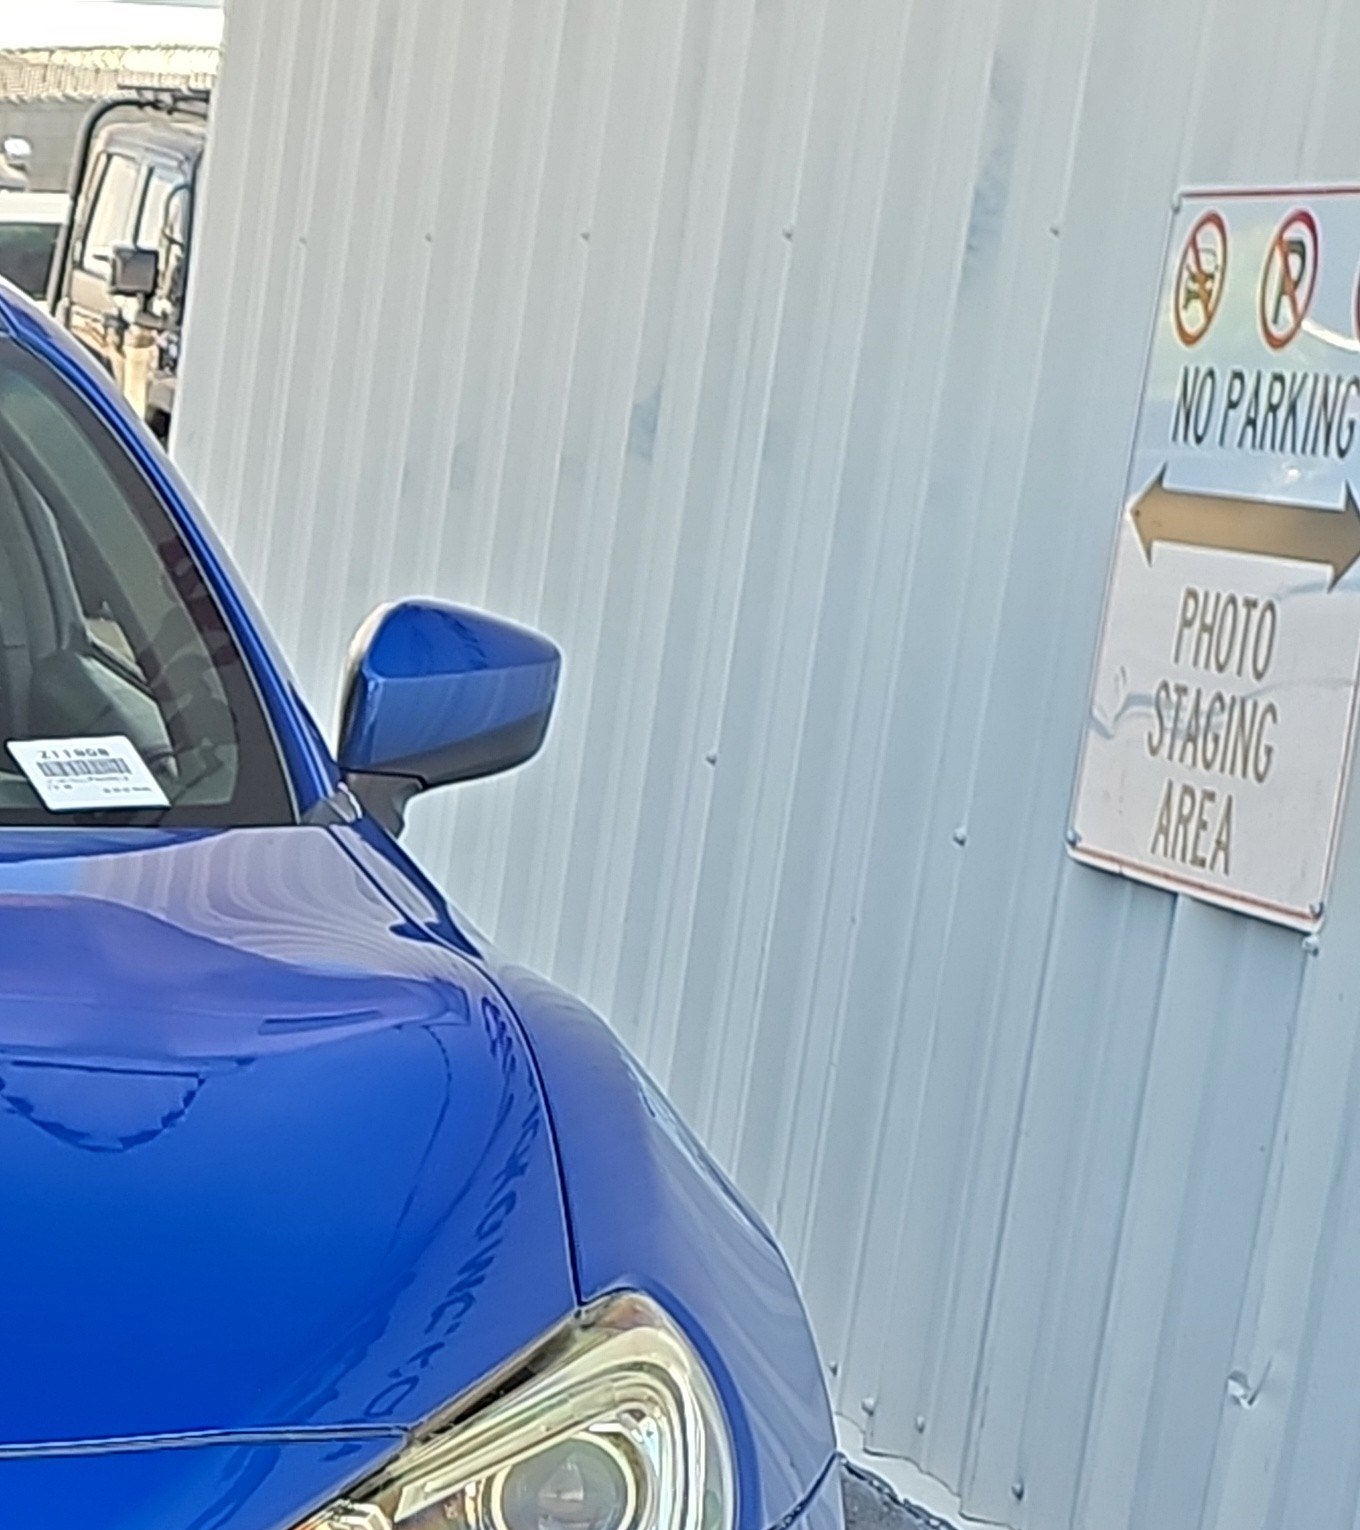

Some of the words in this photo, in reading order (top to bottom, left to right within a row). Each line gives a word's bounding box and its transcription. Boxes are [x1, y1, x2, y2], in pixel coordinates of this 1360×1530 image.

[1171, 365, 1216, 446] NO
[1217, 367, 1360, 460] PARKING
[1173, 586, 1277, 683] PHOTO
[1147, 679, 1278, 784] STAGING
[1150, 778, 1233, 876] AREA
